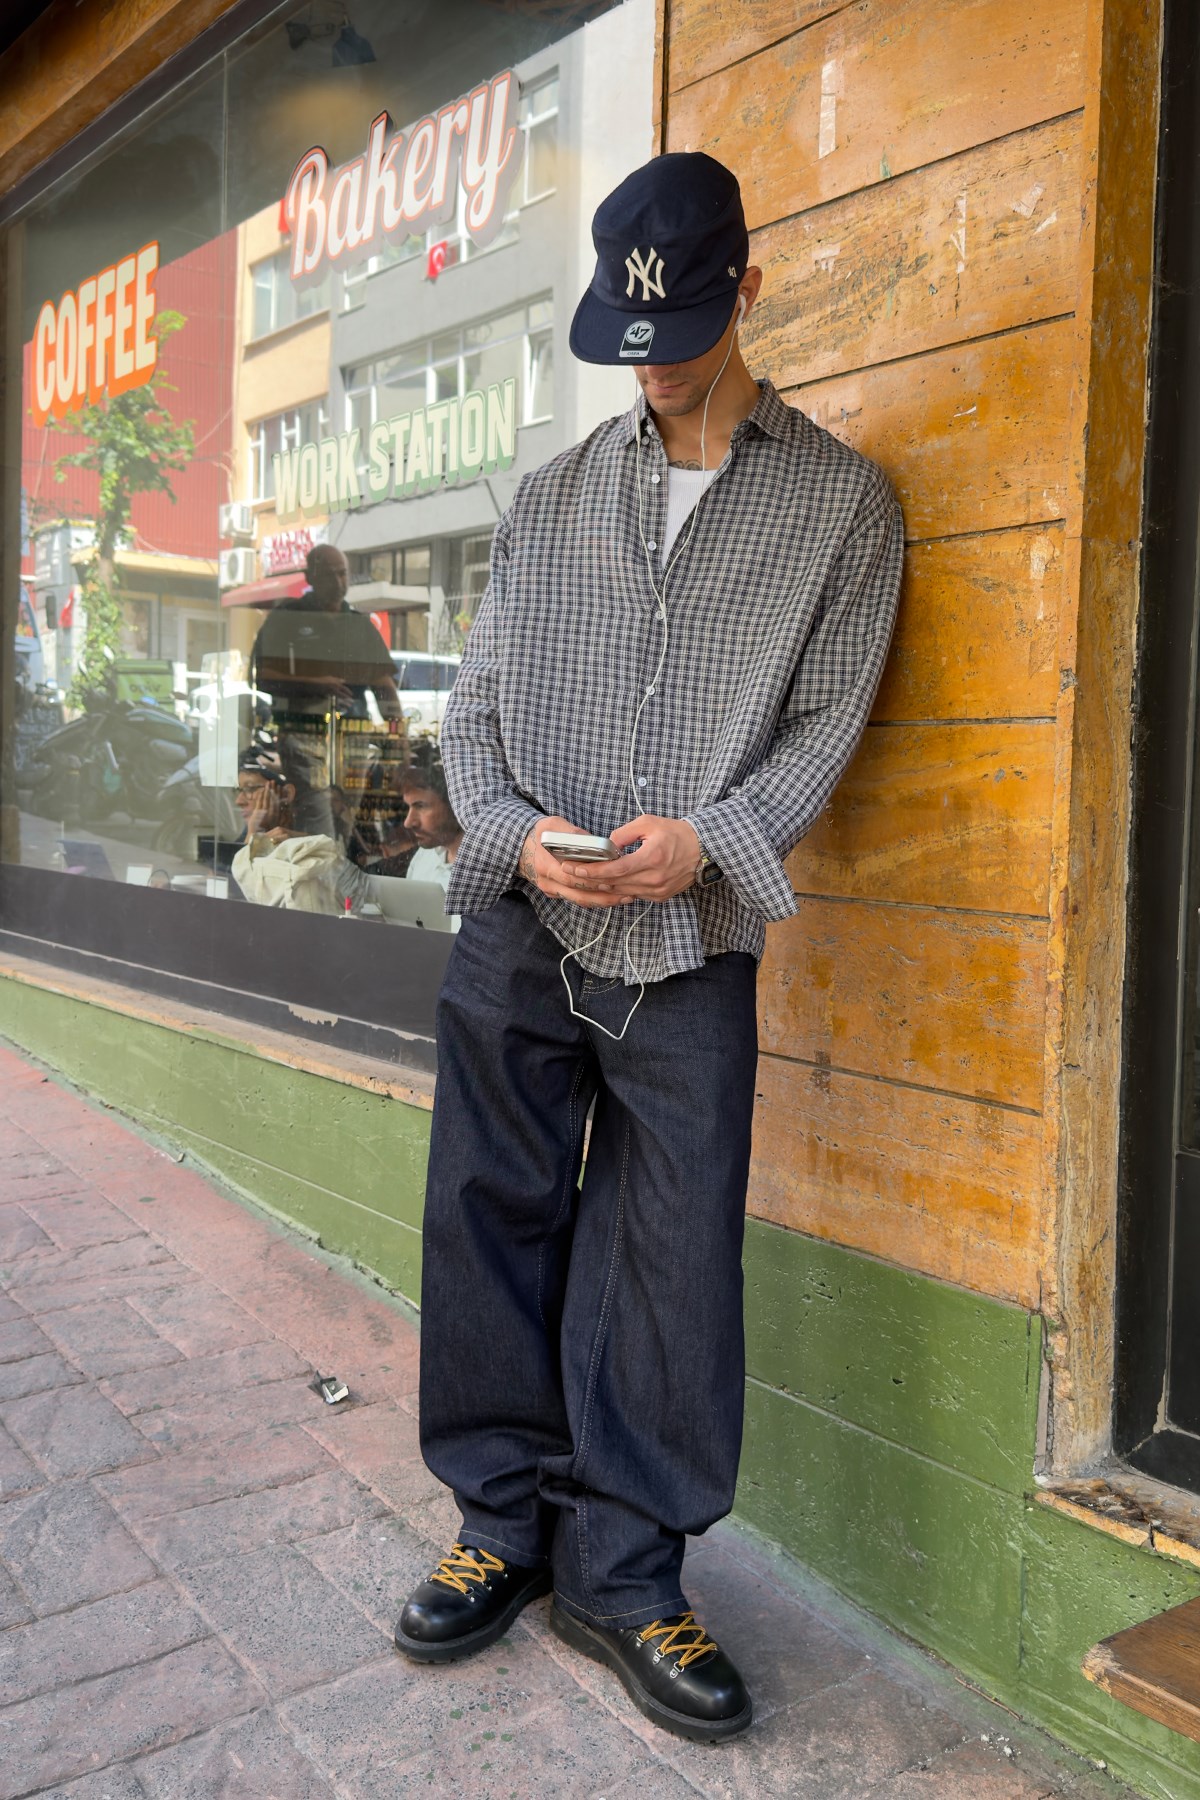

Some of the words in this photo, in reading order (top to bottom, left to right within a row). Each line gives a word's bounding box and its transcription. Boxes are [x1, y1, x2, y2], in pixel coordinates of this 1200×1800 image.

[284, 70, 517, 282] Bakery
[33, 241, 159, 418] COFFEE
[625, 247, 666, 301] NY
[273, 429, 361, 518] WORK
[368, 378, 515, 496] STATION
